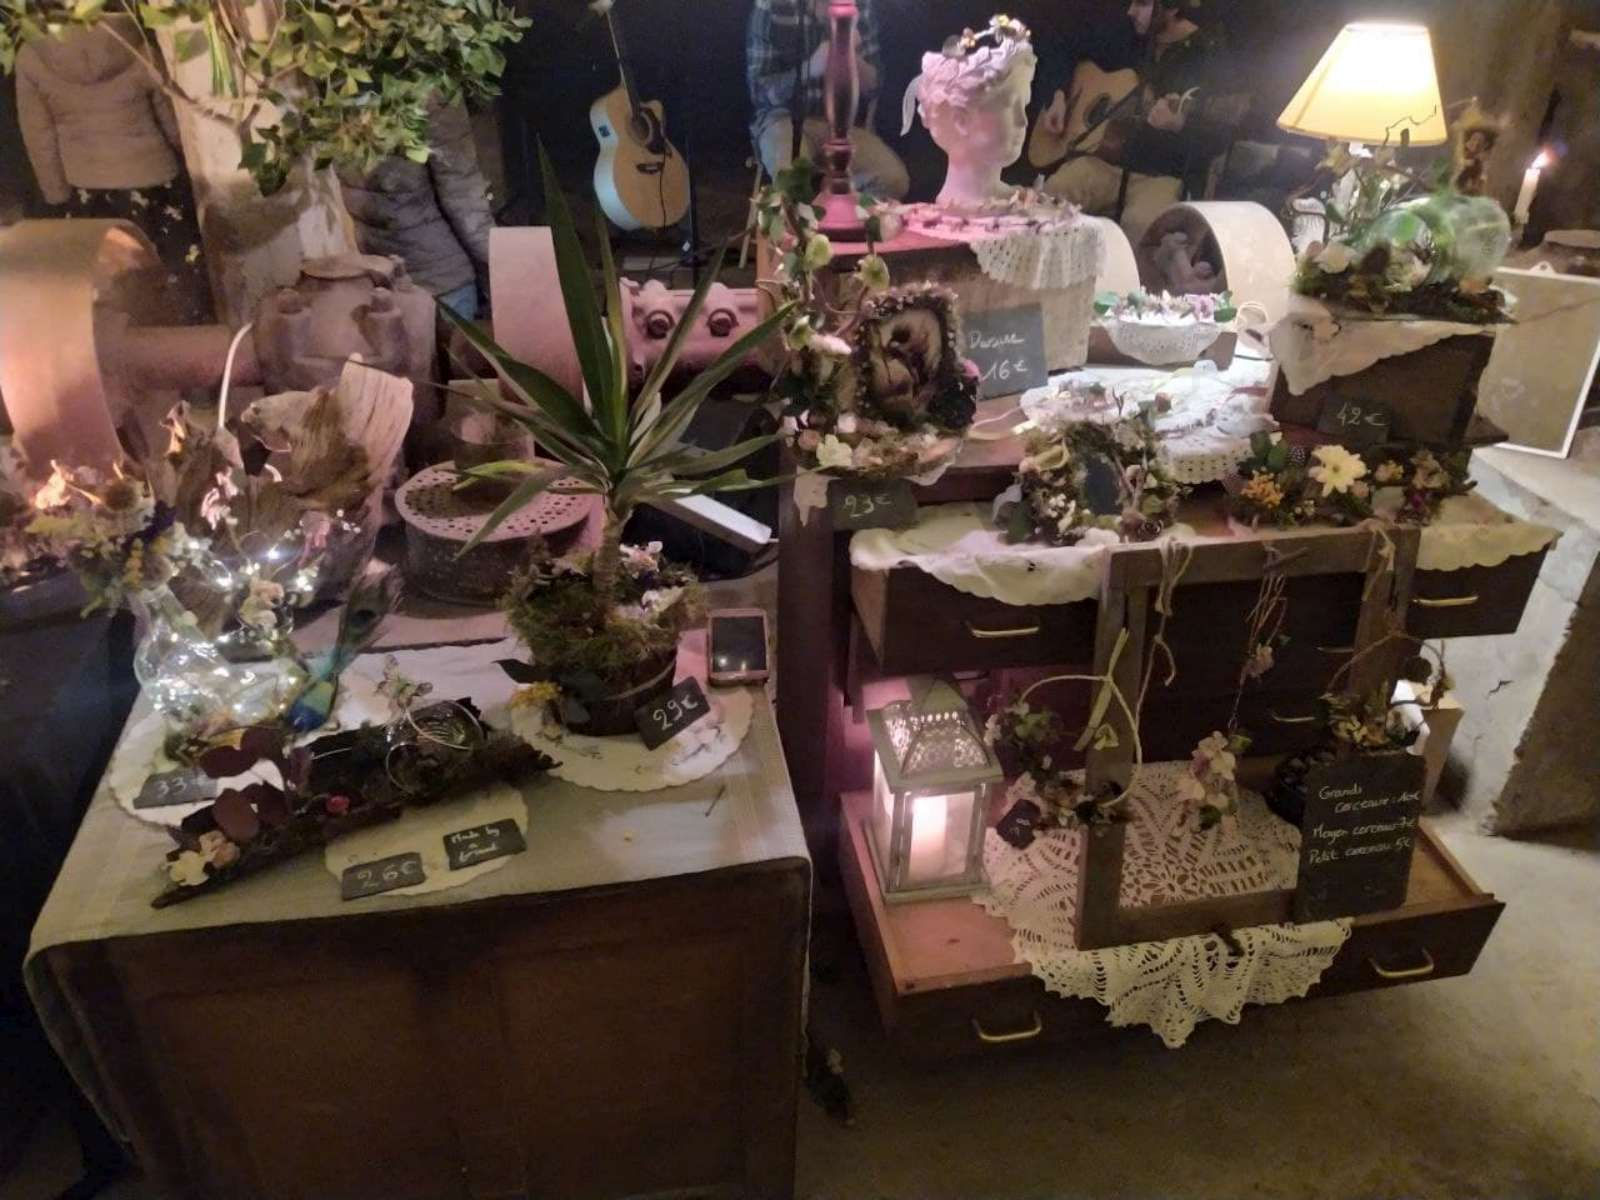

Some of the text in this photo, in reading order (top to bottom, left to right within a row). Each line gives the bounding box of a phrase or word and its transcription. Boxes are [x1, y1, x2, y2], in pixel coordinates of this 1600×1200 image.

[982, 359, 1028, 381] 16€
[1336, 402, 1386, 427] 42€
[653, 694, 698, 731] 29€
